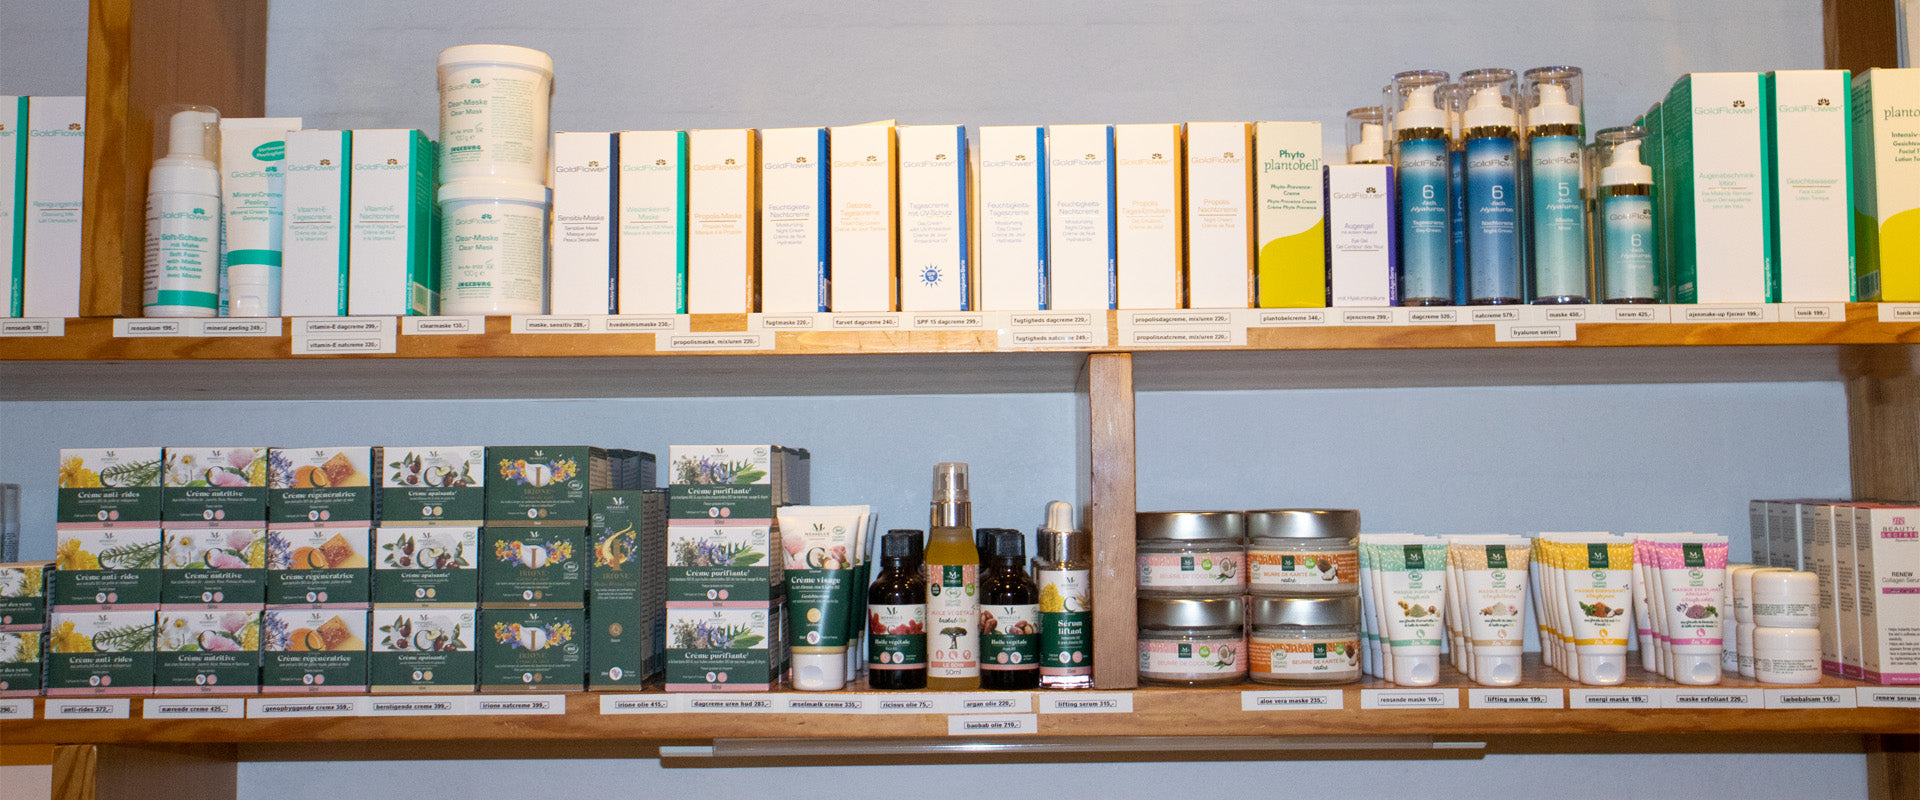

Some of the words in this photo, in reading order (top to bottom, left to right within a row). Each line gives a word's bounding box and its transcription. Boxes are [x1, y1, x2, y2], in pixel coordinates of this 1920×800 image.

[1778, 104, 1842, 113] GoldFlower
[1278, 149, 1305, 160] Phyto
[764, 162, 816, 170] GoldFlower
[903, 160, 955, 168] GoldFlower
[1264, 159, 1319, 173] plantobell
[556, 165, 607, 173] GoldFlower
[1422, 184, 1434, 199] 6
[1491, 185, 1504, 200] 6
[1558, 182, 1570, 197] 5
[1344, 222, 1374, 230] Augengel
[1631, 233, 1642, 247] 6
[77, 491, 102, 499] Crème
[282, 491, 306, 499] Crème
[687, 487, 711, 496] Crème
[75, 573, 100, 581] Crème
[685, 569, 709, 577] Crème
[791, 576, 816, 584] Crème
[1057, 618, 1083, 628] Sérum
[1058, 627, 1082, 636] liftant
[178, 654, 203, 662] Crème
[277, 654, 301, 662] Crème
[684, 651, 708, 660] Crème
[69, 656, 94, 664] Crème
